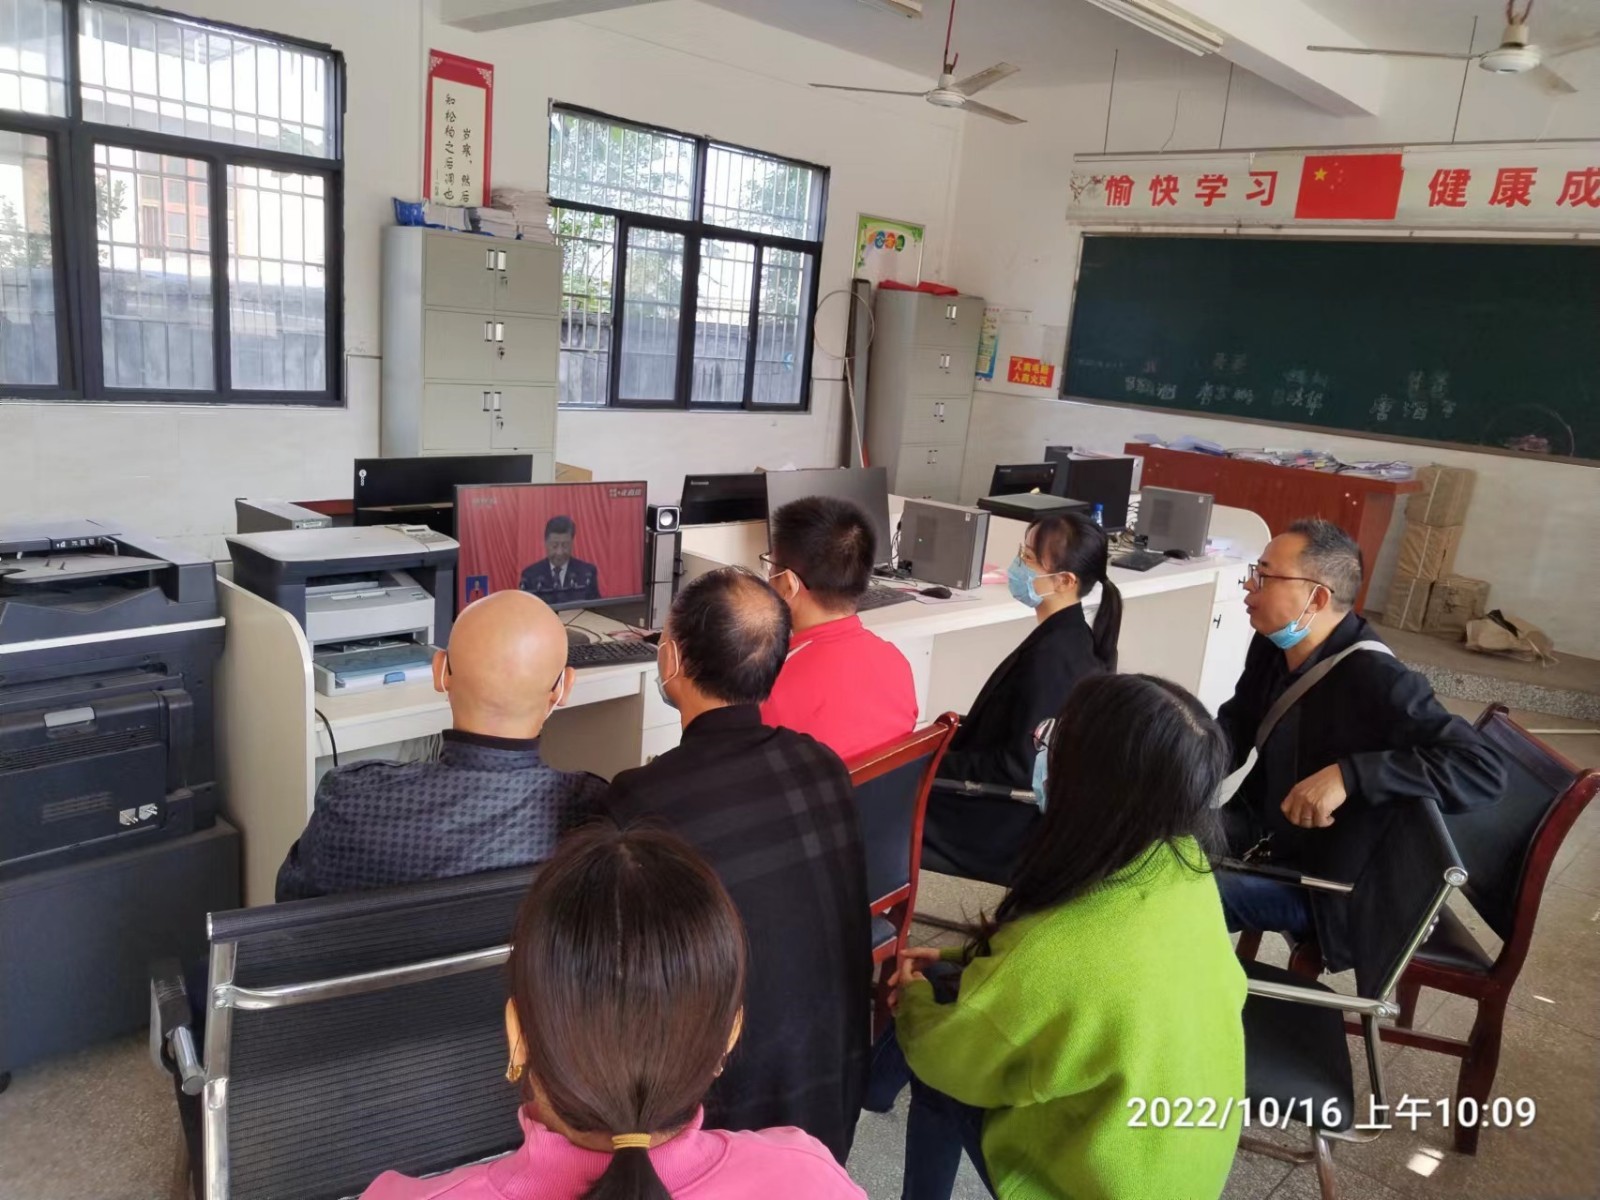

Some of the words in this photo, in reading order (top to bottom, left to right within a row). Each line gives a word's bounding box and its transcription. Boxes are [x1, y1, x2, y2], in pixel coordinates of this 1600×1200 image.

[1105, 171, 1279, 208] 愉快学习
[1428, 168, 1600, 209] 健康成
